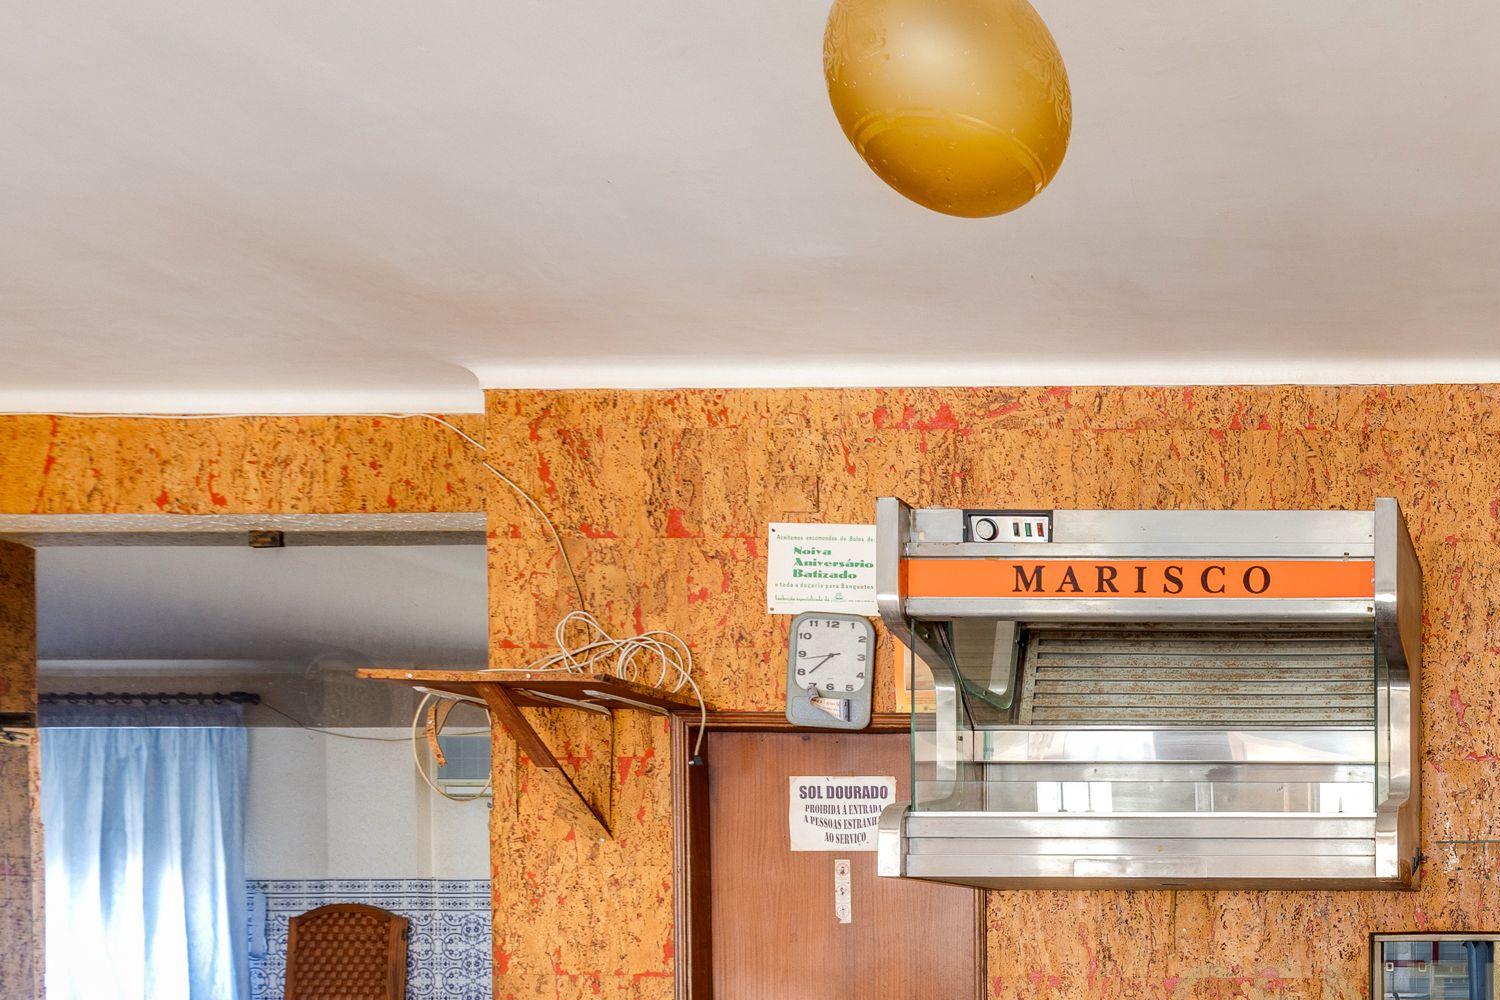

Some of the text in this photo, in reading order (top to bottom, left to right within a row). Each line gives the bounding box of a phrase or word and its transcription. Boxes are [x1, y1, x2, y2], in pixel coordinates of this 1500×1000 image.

[793, 546, 832, 555] Noiva
[793, 558, 874, 568] Aniversário
[792, 570, 857, 579] Batizado
[1012, 565, 1271, 594] MARISCO
[826, 621, 840, 629] 12
[799, 632, 812, 640] 10
[798, 650, 807, 658] 9
[797, 668, 806, 676] 8
[826, 683, 835, 691] 6
[845, 684, 854, 692] 5
[799, 785, 888, 799] SOL DOURADO
[805, 804, 882, 815] PROIBIDA A ENTRADA
[804, 814, 880, 830] A PESSOAS ESTRANH
[824, 832, 834, 843] AO
